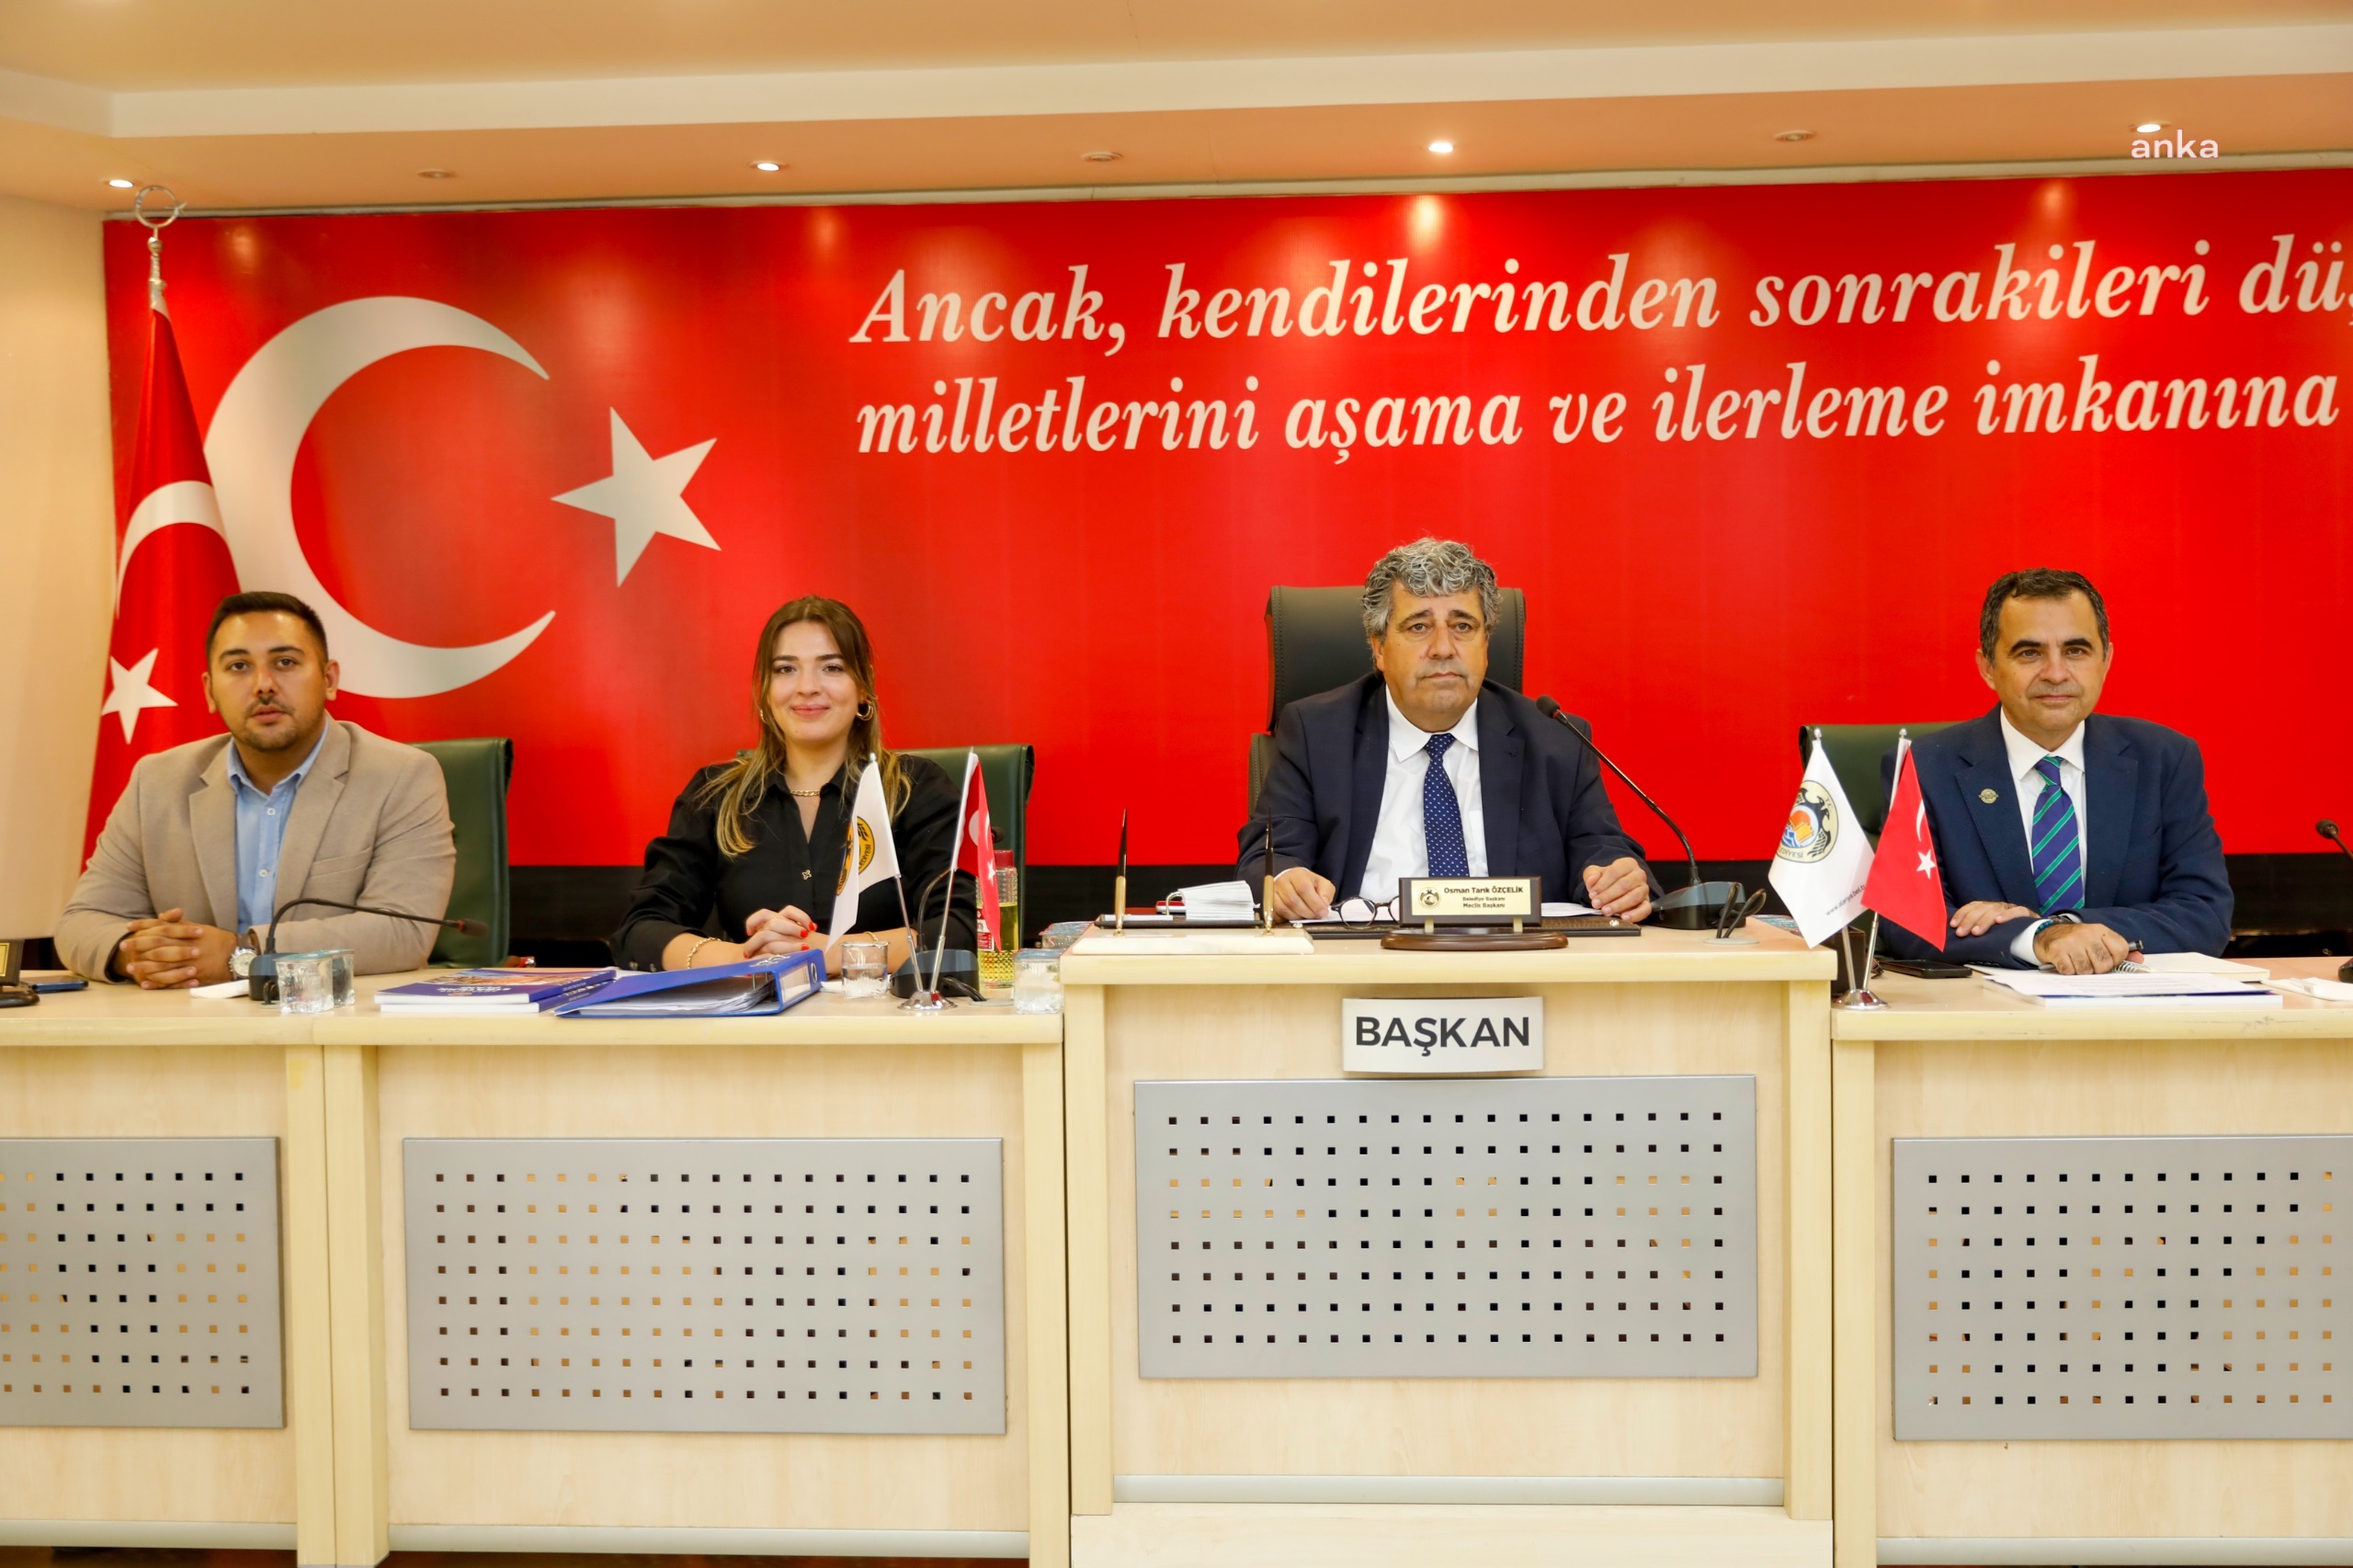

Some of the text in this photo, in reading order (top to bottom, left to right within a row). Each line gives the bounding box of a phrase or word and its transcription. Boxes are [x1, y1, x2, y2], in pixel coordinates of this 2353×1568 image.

[849, 265, 1125, 357] Ancak,
[1158, 254, 1720, 339] kendilerinden
[1749, 240, 2209, 327] sonrakileri
[857, 354, 2339, 465] milletlerini aşama ve ilerleme imkanına
[1492, 886, 1523, 894] ÖZÇELİK
[1356, 1016, 1529, 1057] BAŞKAN
